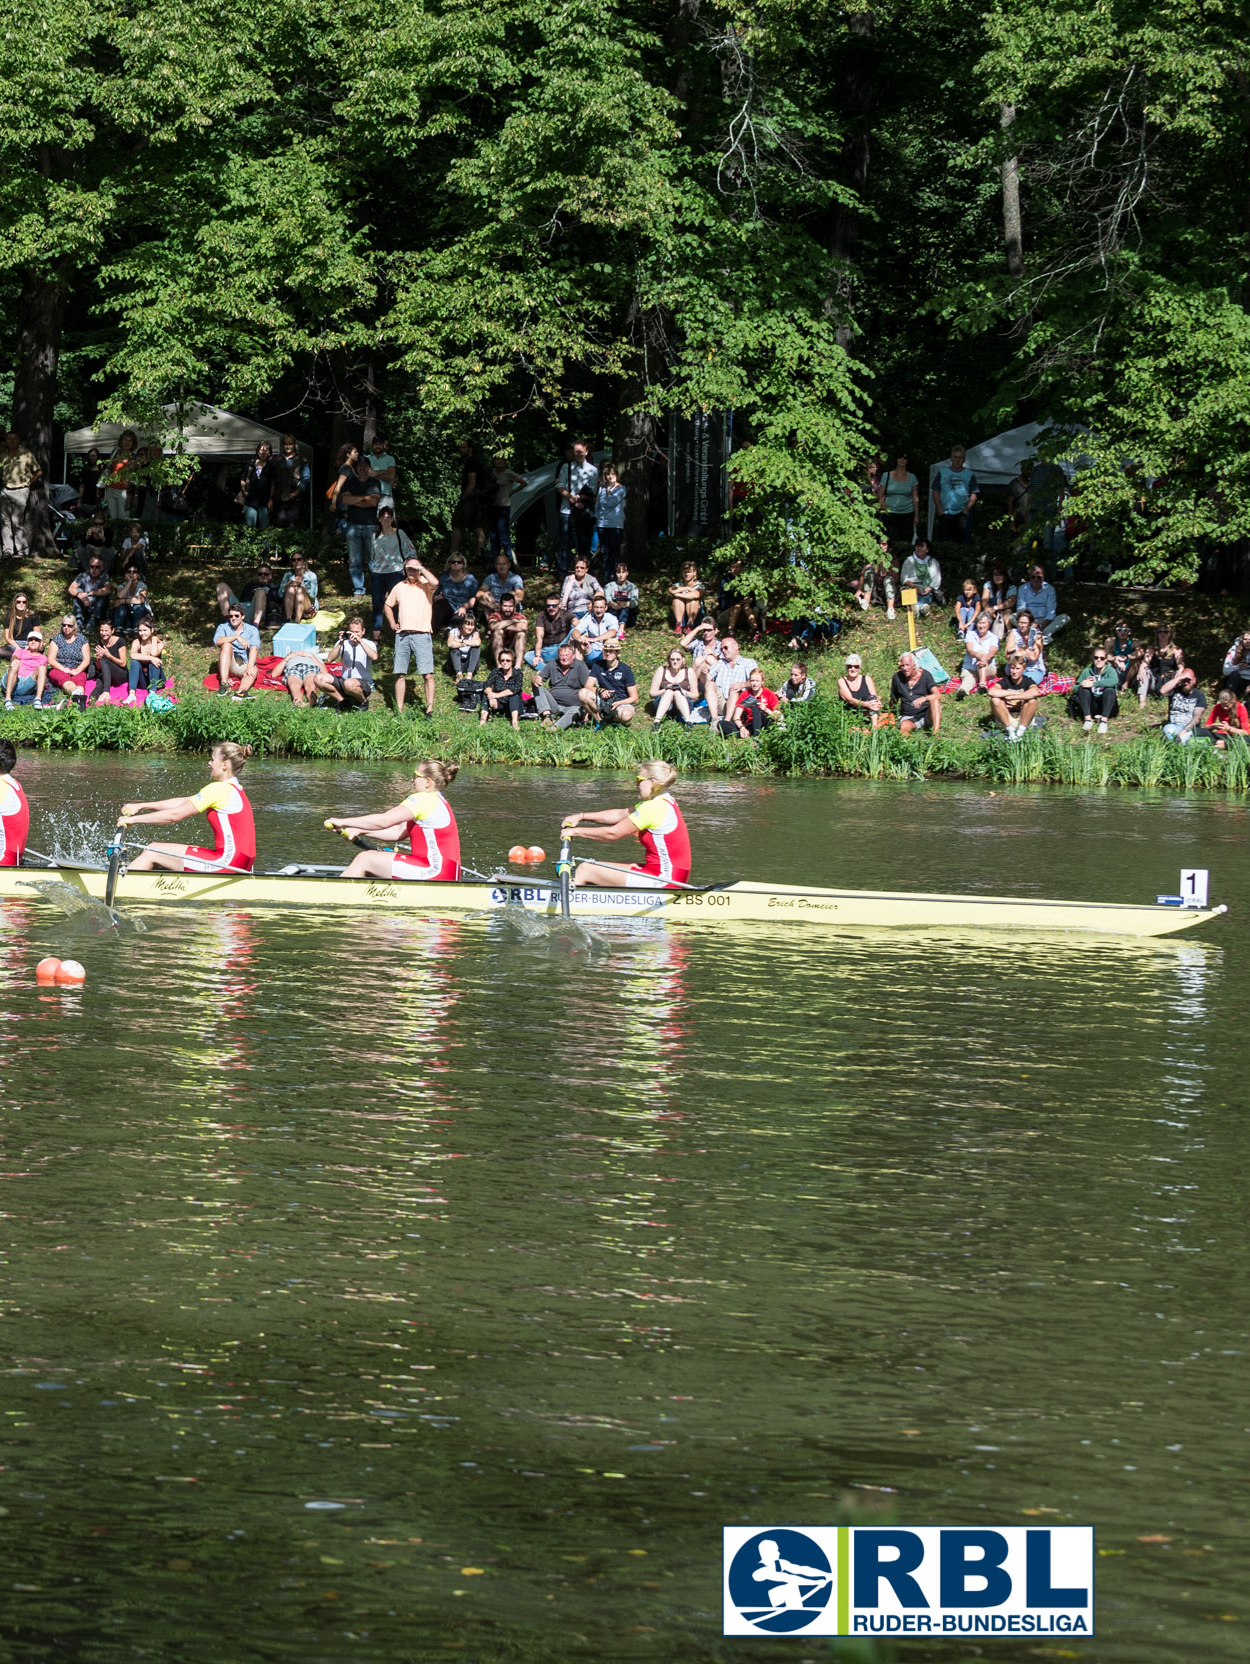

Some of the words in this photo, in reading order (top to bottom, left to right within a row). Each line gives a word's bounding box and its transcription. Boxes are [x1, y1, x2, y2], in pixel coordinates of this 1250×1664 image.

[700, 440, 710, 499] Veranstaltungs
[700, 499, 709, 525] GmbH
[151, 874, 186, 891] Melitta
[363, 881, 398, 898] Melitta
[1186, 873, 1196, 895] 1
[510, 888, 546, 902] RBL
[673, 894, 681, 905] Z
[686, 895, 703, 905] BS
[707, 895, 731, 906] 001
[768, 897, 795, 908] Erich
[798, 899, 839, 910] Domeier
